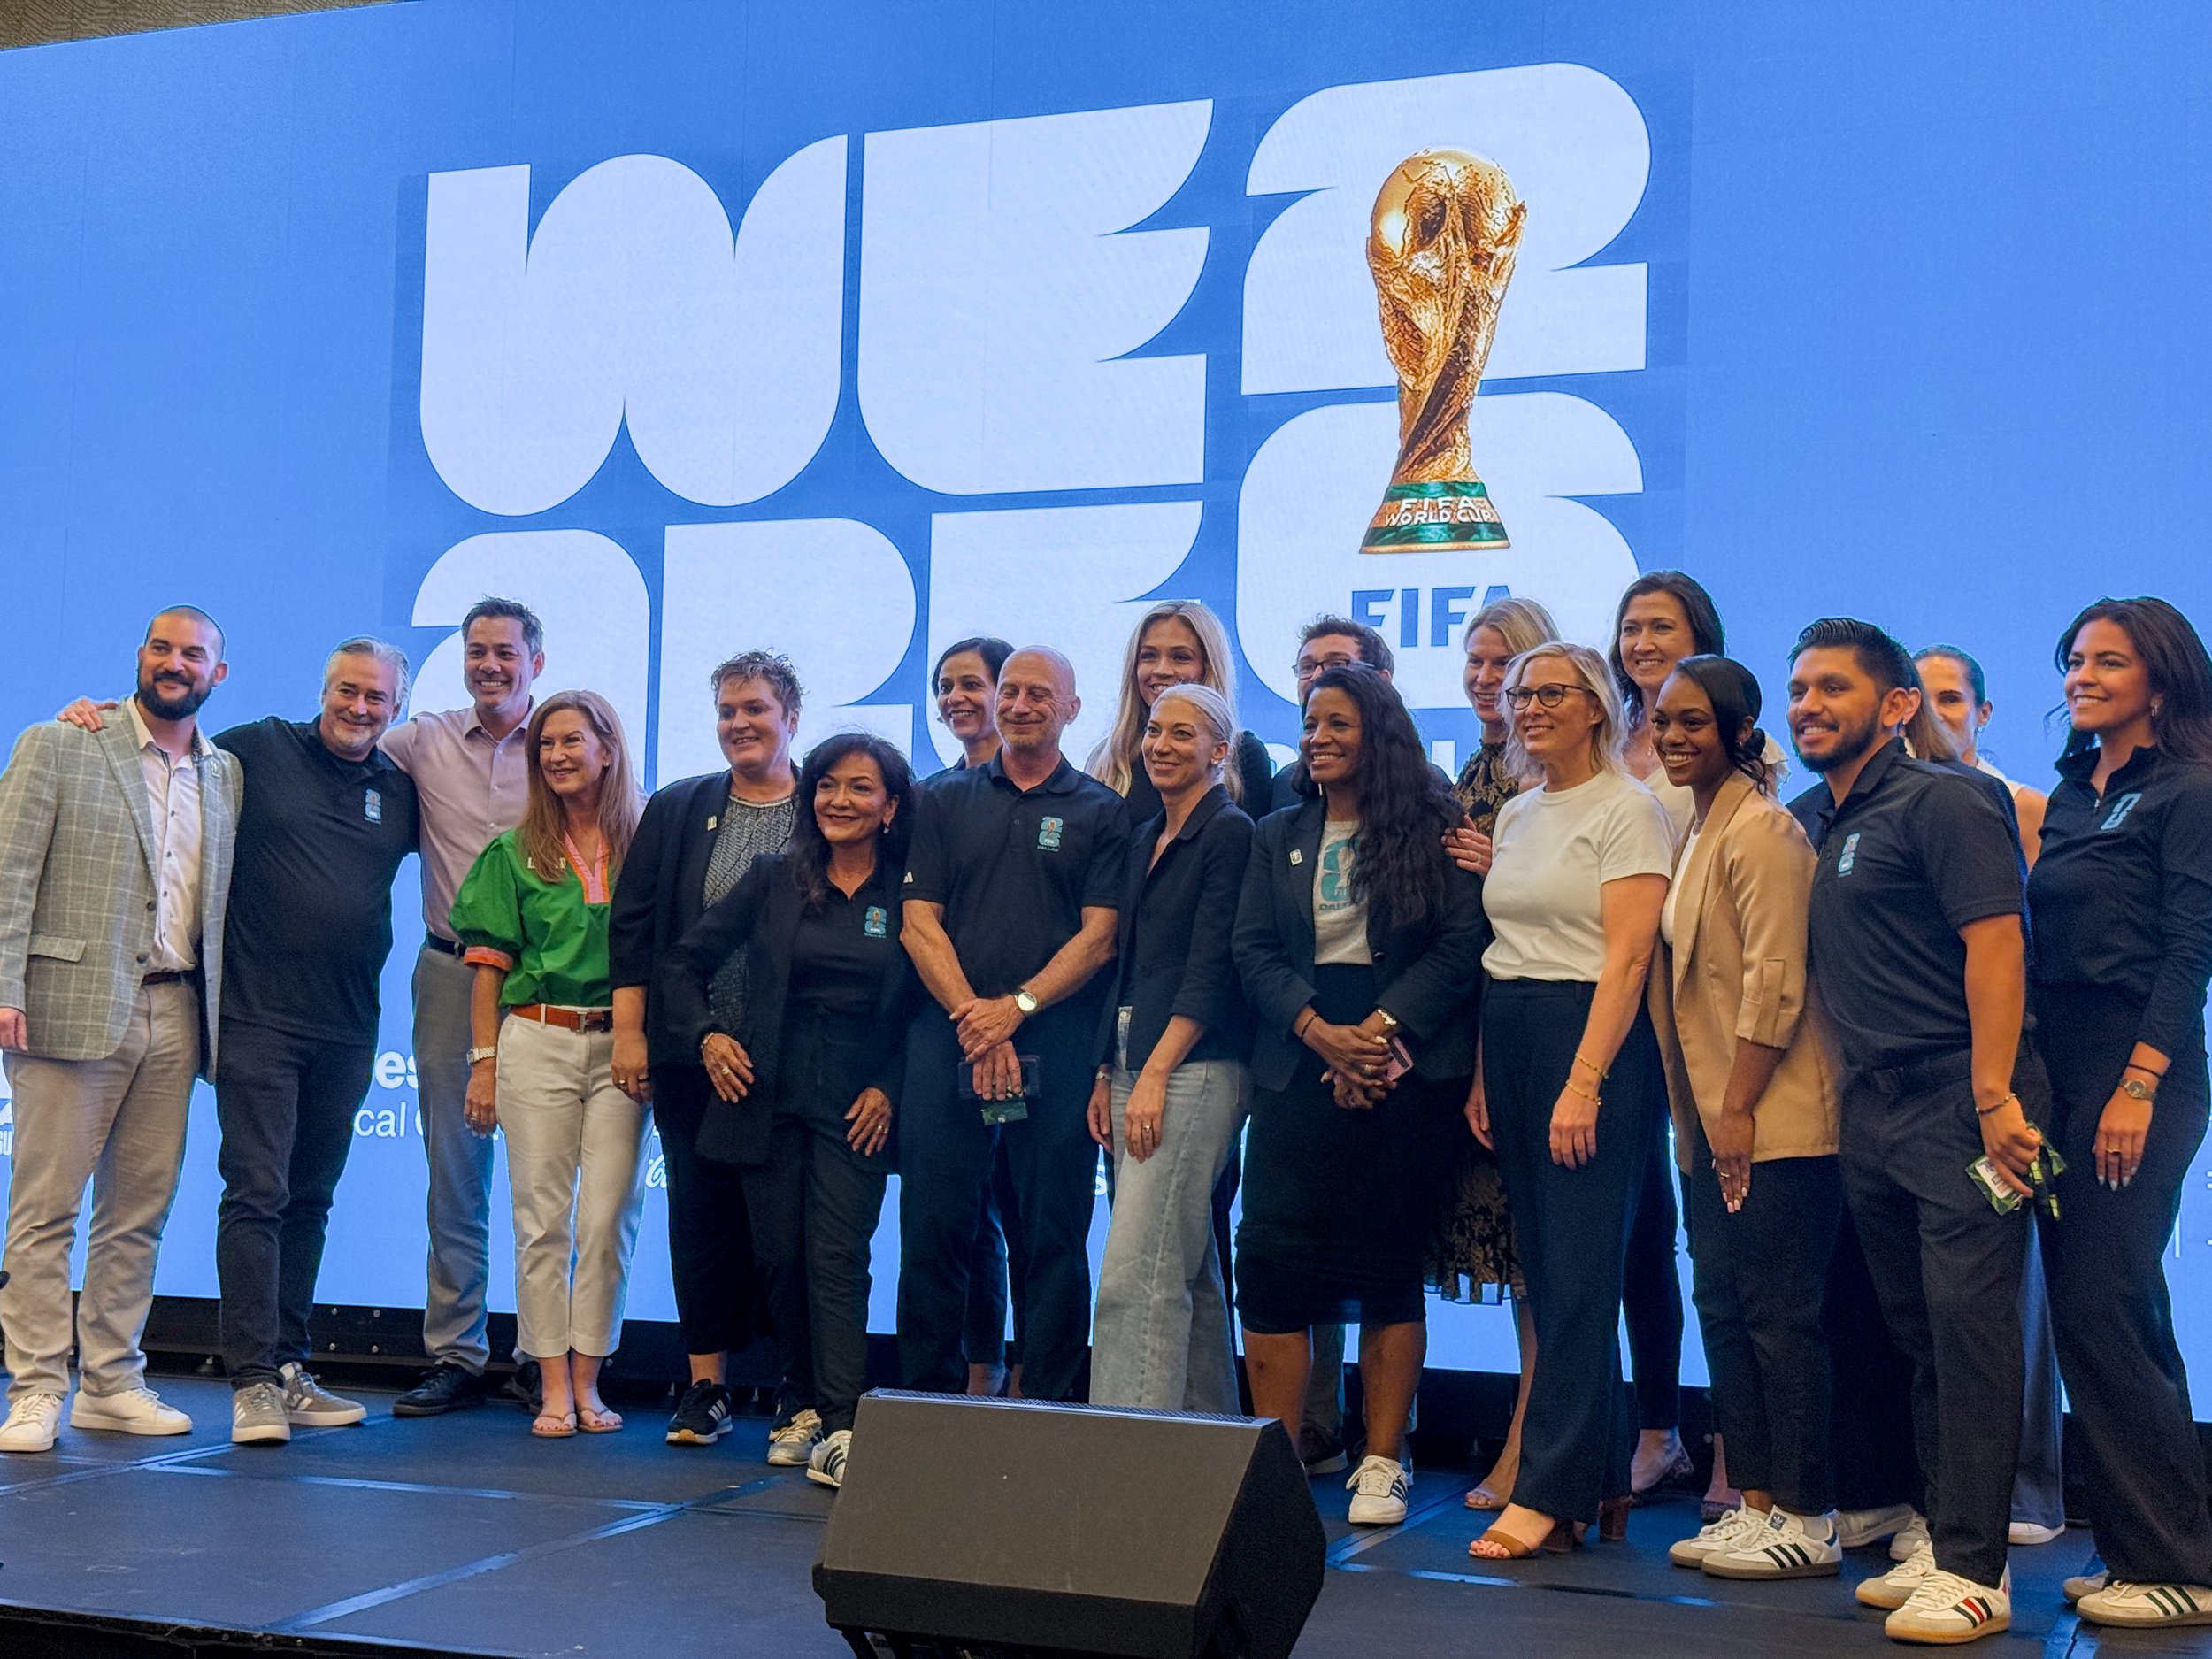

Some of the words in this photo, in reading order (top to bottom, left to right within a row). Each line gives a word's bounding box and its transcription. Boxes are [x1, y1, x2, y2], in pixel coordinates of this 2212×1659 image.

[419, 98, 1214, 518] WE
[1400, 495, 1475, 511] FIFA
[1384, 507, 1449, 526] WORLD
[1456, 507, 1493, 523] CUP
